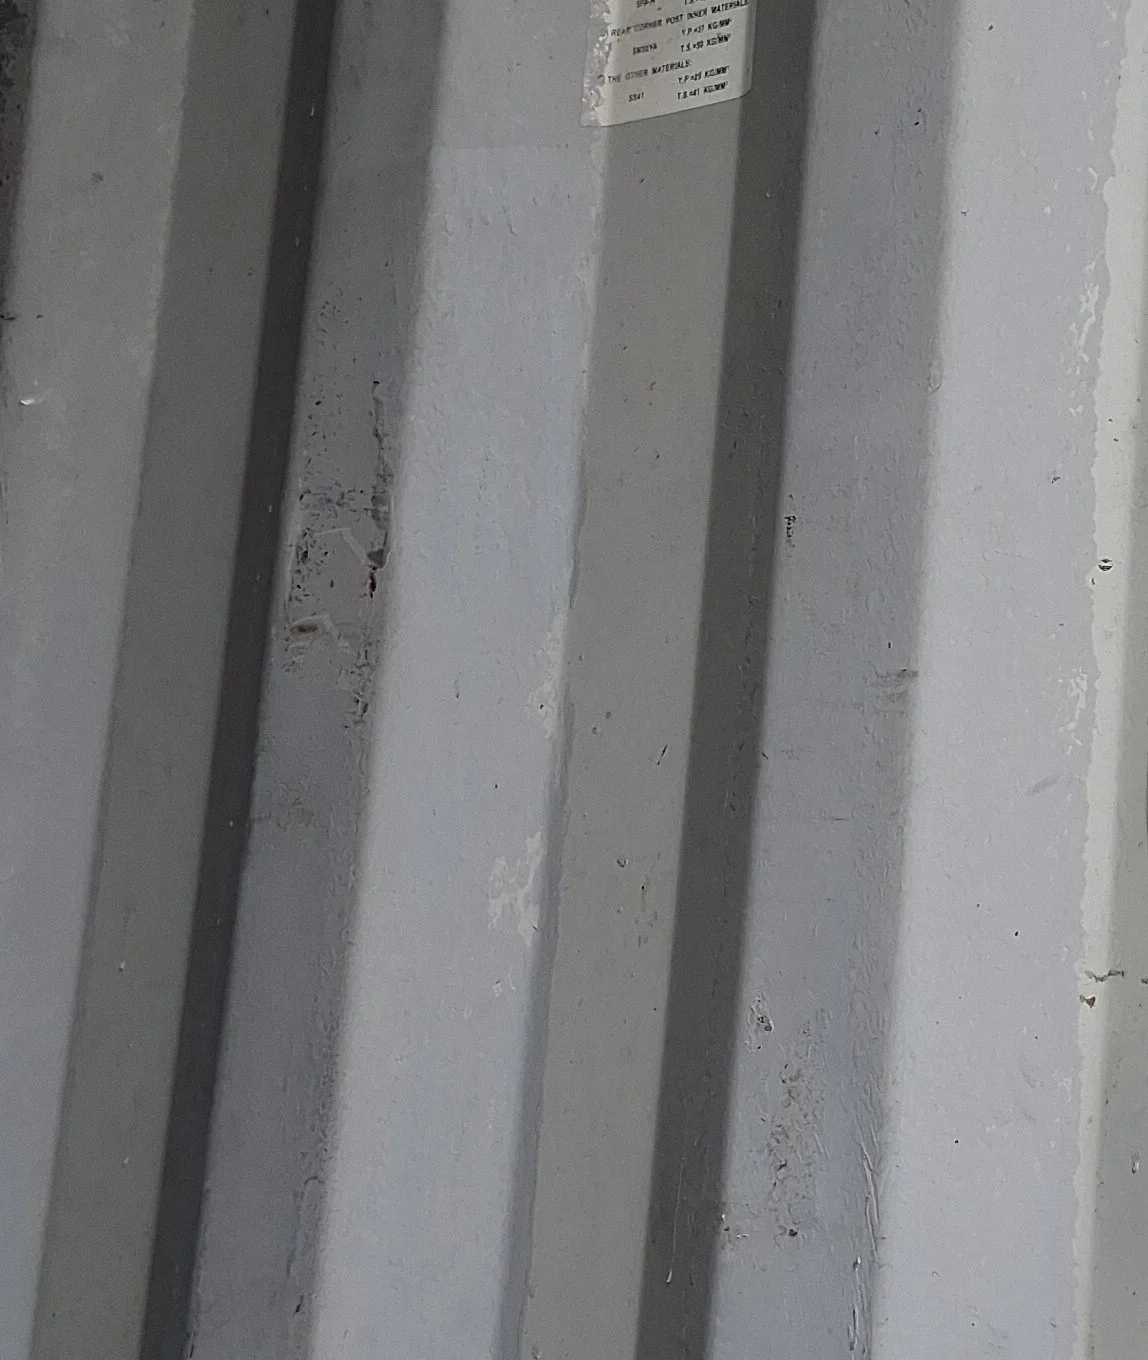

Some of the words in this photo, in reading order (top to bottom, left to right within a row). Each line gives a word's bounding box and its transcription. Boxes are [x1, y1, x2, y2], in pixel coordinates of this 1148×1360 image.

[611, 25, 631, 37] REAR
[633, 18, 663, 33] CORNER
[665, 13, 684, 26] POST
[687, 6, 708, 20] INNER
[607, 73, 622, 84] THE
[625, 68, 649, 81] OTHER
